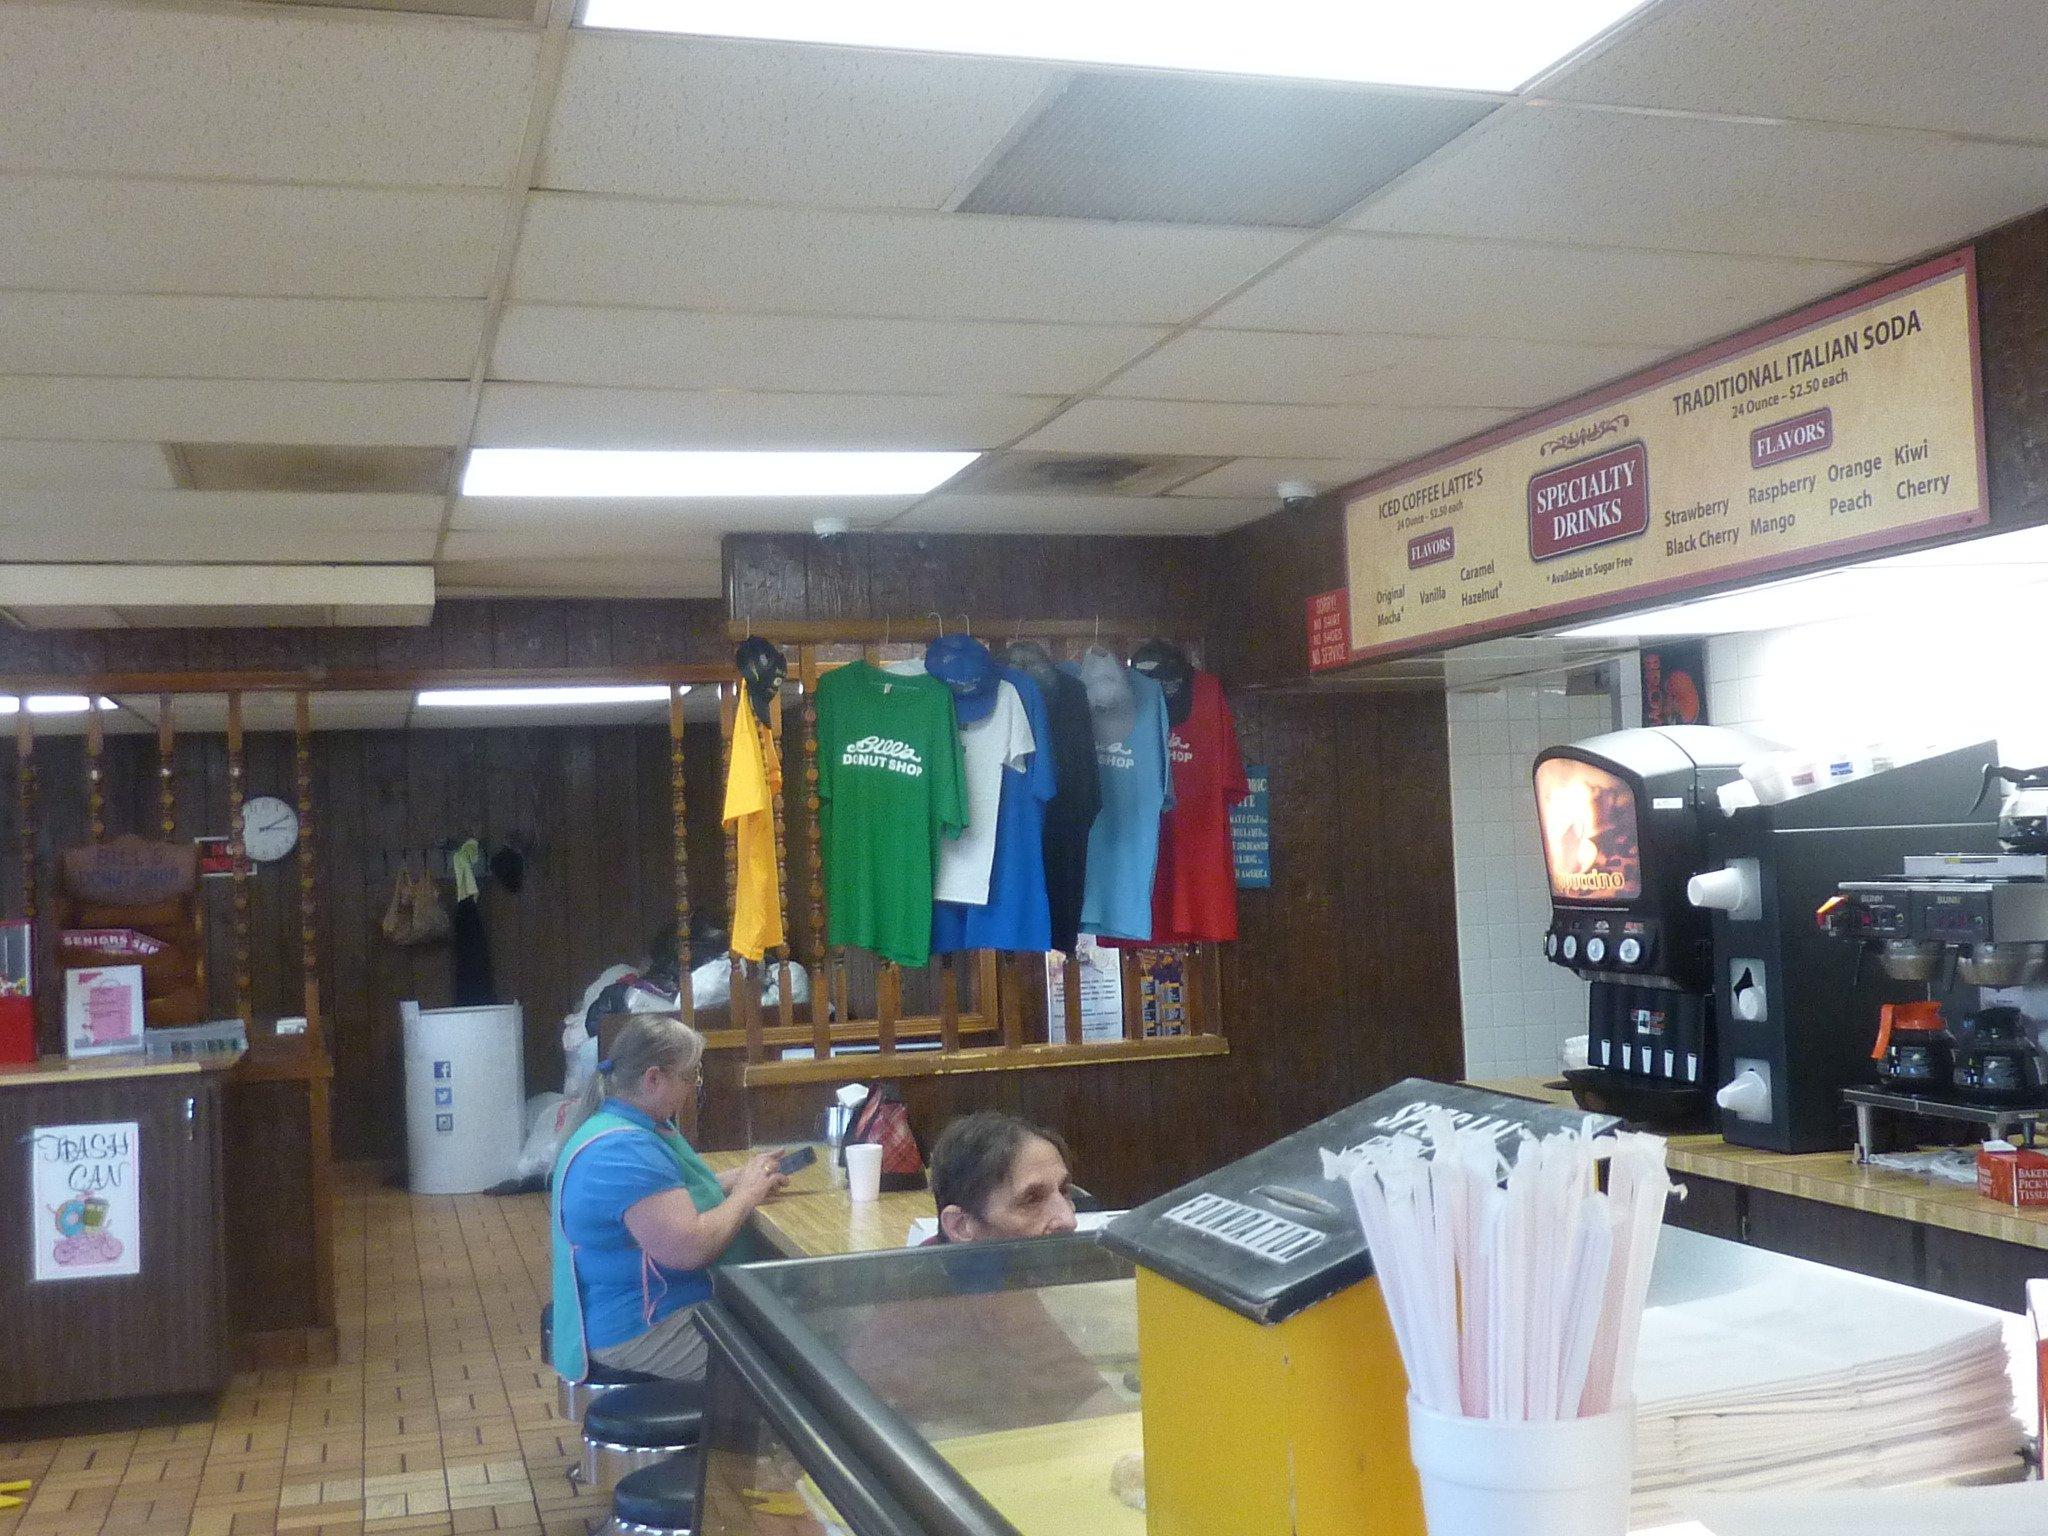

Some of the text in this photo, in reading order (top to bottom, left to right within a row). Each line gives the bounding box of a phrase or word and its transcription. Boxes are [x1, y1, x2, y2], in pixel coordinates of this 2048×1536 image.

[1673, 309, 1922, 416] TRADITIONAL ITALIAN SODA
[1732, 404, 1745, 419] 24
[1746, 394, 1779, 415] Ounce
[1789, 379, 1820, 400] $2.50
[1822, 369, 1849, 388] each
[1756, 420, 1826, 458] FLAVORS
[1894, 438, 1929, 466] Kiwi
[1828, 455, 1883, 483] Orange
[1379, 467, 1483, 520] ICED COFFEE LATTE'S
[1537, 460, 1636, 514] SPECIALTY
[1749, 474, 1816, 505] Raspberry
[1896, 473, 1950, 501] Cherry
[1665, 498, 1730, 527] Strawberry
[1830, 490, 1872, 516] Peach
[1405, 515, 1424, 528] Ounce
[1553, 498, 1622, 541] DRINKS
[1750, 512, 1796, 537] Mango
[1411, 536, 1450, 561] FLAVORS
[1666, 526, 1740, 557] Black Cherry
[1461, 558, 1495, 581] Caramel
[1552, 556, 1633, 584] Available in Sugar Free
[1377, 584, 1405, 605] Original
[1420, 588, 1446, 605] Vanilla
[846, 736, 922, 763] Bill's
[843, 753, 923, 777] DONUT SHOP
[64, 935, 128, 946] SENIORS
[35, 1131, 129, 1163] TRASH
[68, 1161, 131, 1192] CAN
[1162, 1193, 1327, 1264] FOUNDATION
